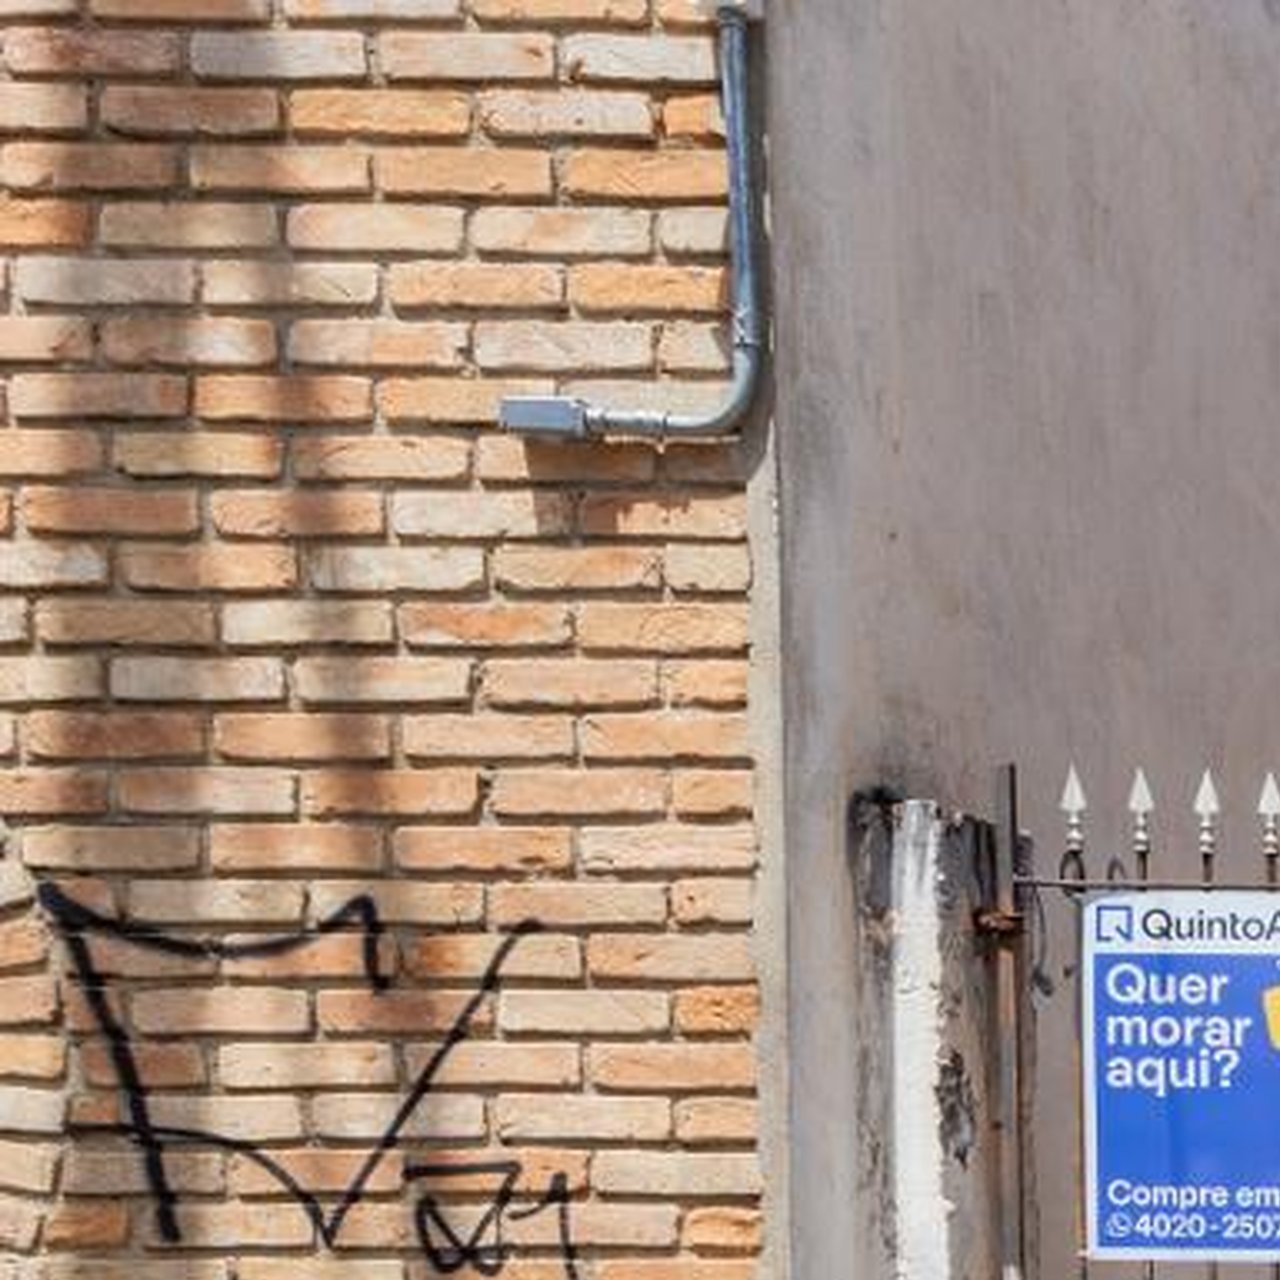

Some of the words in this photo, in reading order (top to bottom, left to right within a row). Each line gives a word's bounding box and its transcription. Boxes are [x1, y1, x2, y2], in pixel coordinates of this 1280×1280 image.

[1107, 963, 1228, 1004] Quer
[1107, 1015, 1251, 1047] morar
[1107, 1049, 1239, 1097] aqui?
[1108, 1179, 1229, 1209] Compre
